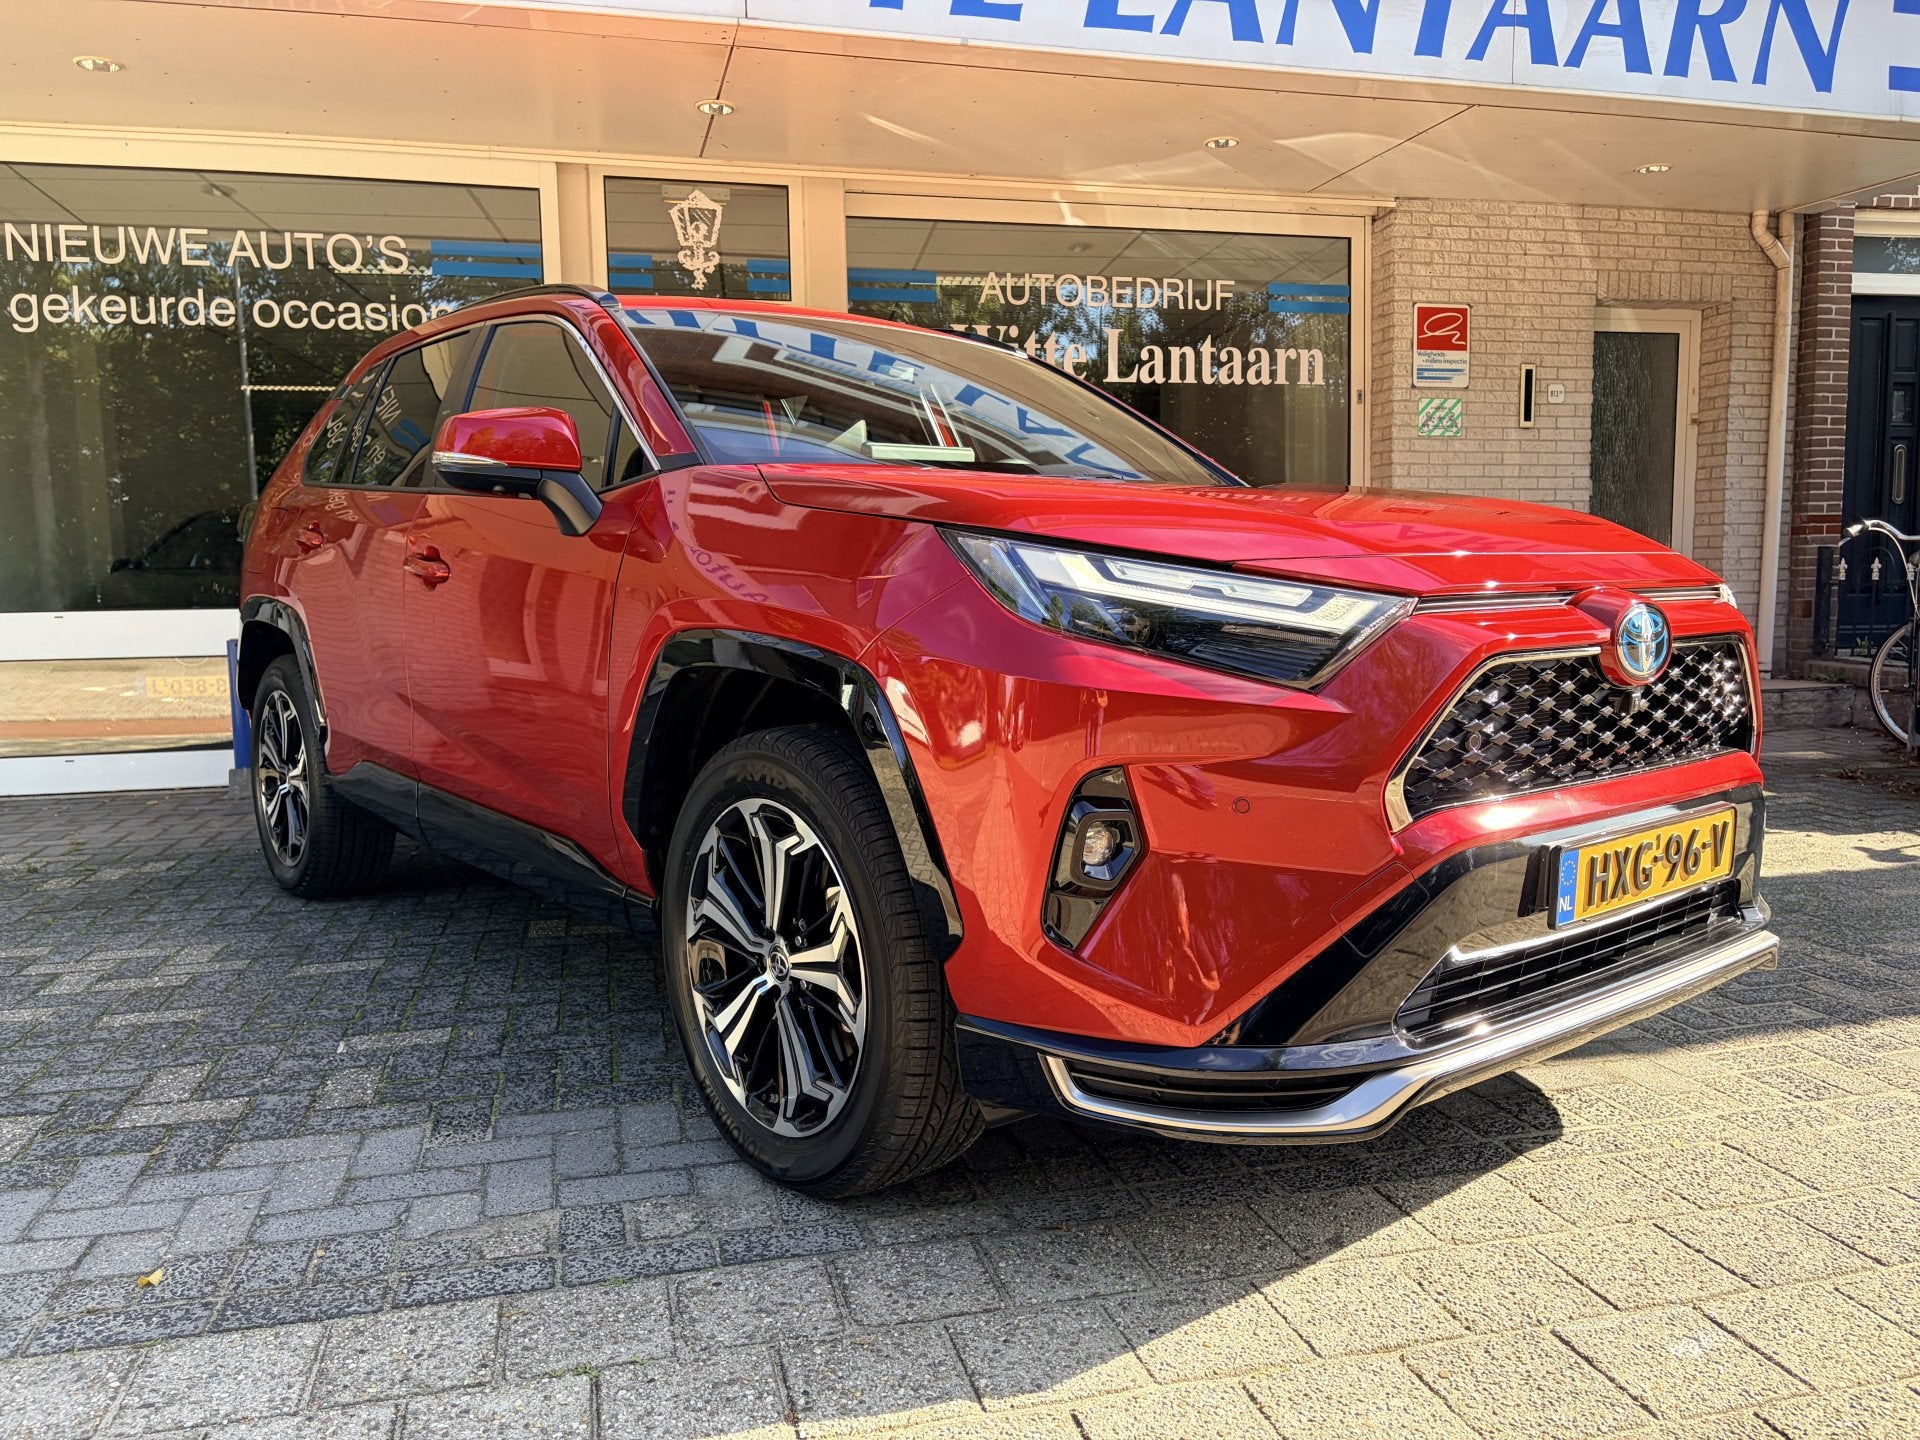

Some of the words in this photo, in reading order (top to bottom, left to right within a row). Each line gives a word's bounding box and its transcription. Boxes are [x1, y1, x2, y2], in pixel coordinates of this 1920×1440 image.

[4, 222, 211, 267] NIEUWE
[226, 229, 409, 275] AUTO'S
[9, 285, 236, 334] gekeurde
[979, 271, 1235, 311] AUTOBEDRIJF
[1102, 328, 1325, 386] Lantaarn
[1585, 820, 1730, 909] HXG-96-V
[1559, 895, 1573, 913] NL
